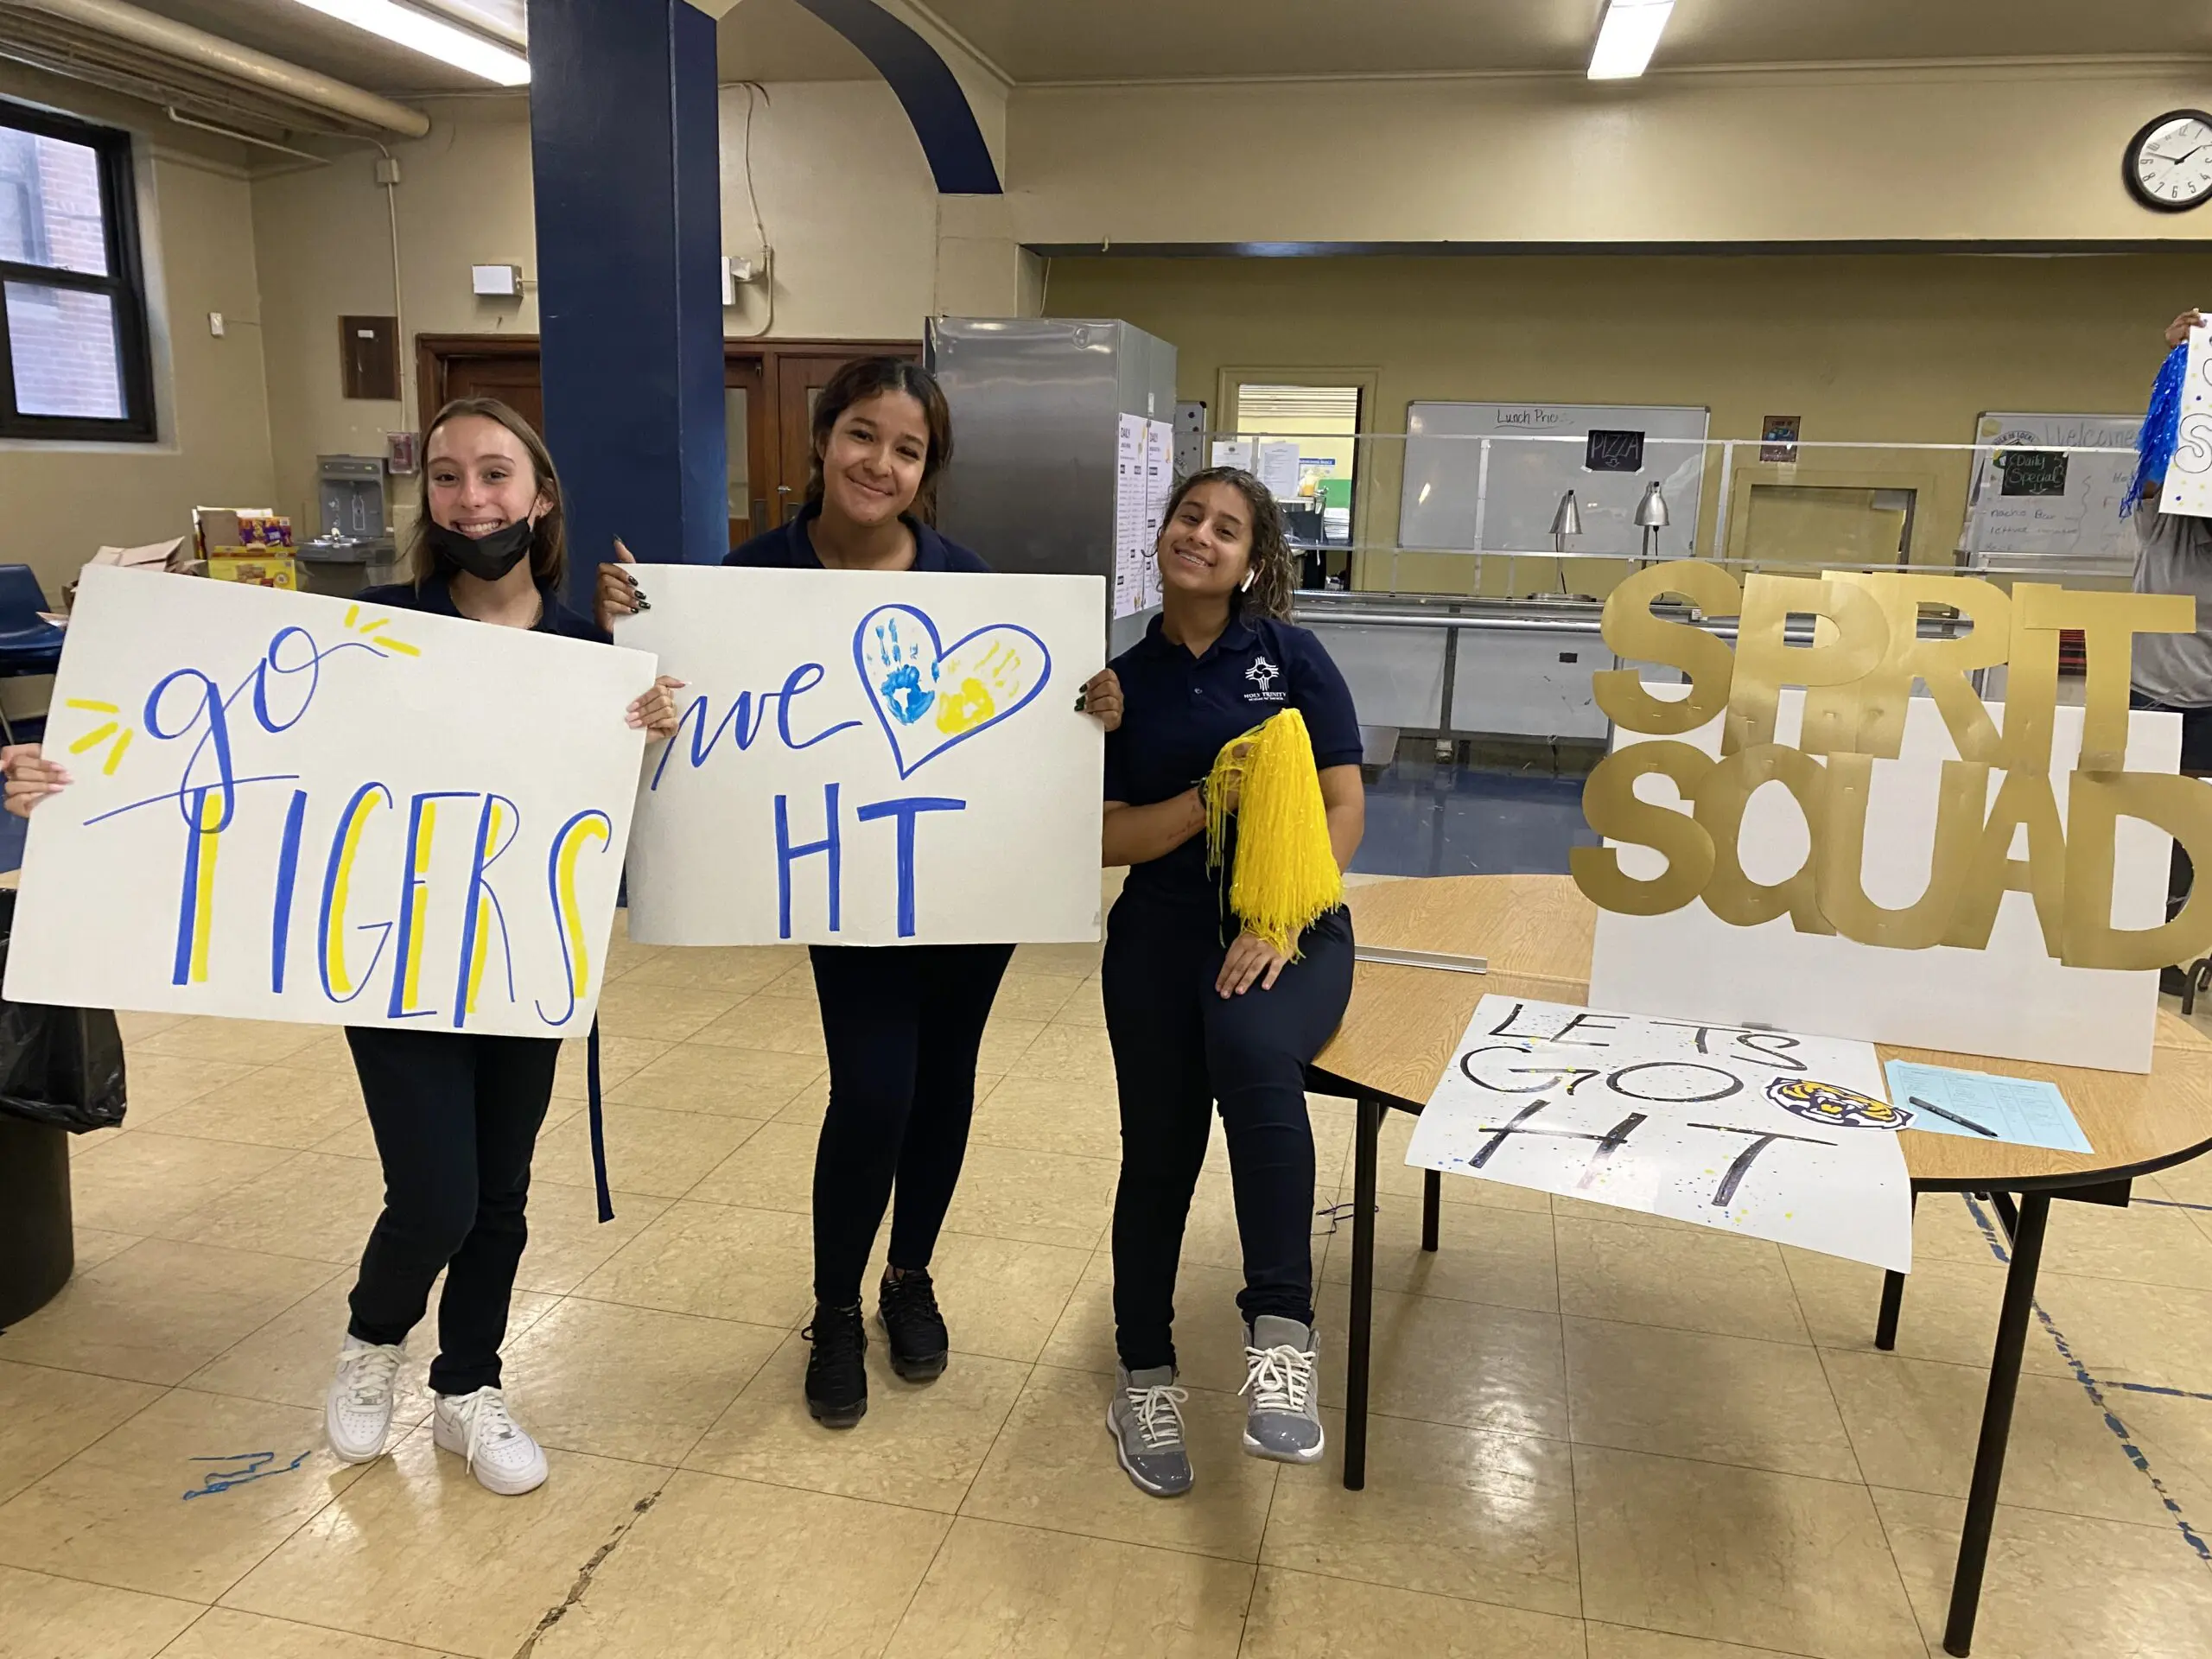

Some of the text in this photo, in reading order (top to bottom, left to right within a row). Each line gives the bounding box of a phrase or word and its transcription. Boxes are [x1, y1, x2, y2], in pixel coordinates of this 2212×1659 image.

[1497, 409, 1530, 424] Lunch
[1591, 433, 1639, 460] PIZZA
[2017, 454, 2045, 469] Daily
[2009, 467, 2061, 486] Special
[84, 626, 388, 834] go
[652, 663, 862, 791] we
[173, 775, 613, 1028] TIGERS
[774, 783, 966, 938] HT
[1569, 740, 2212, 971] SQUAD
[1459, 1046, 1745, 1103] GO
[1468, 1098, 1838, 1207] HT
